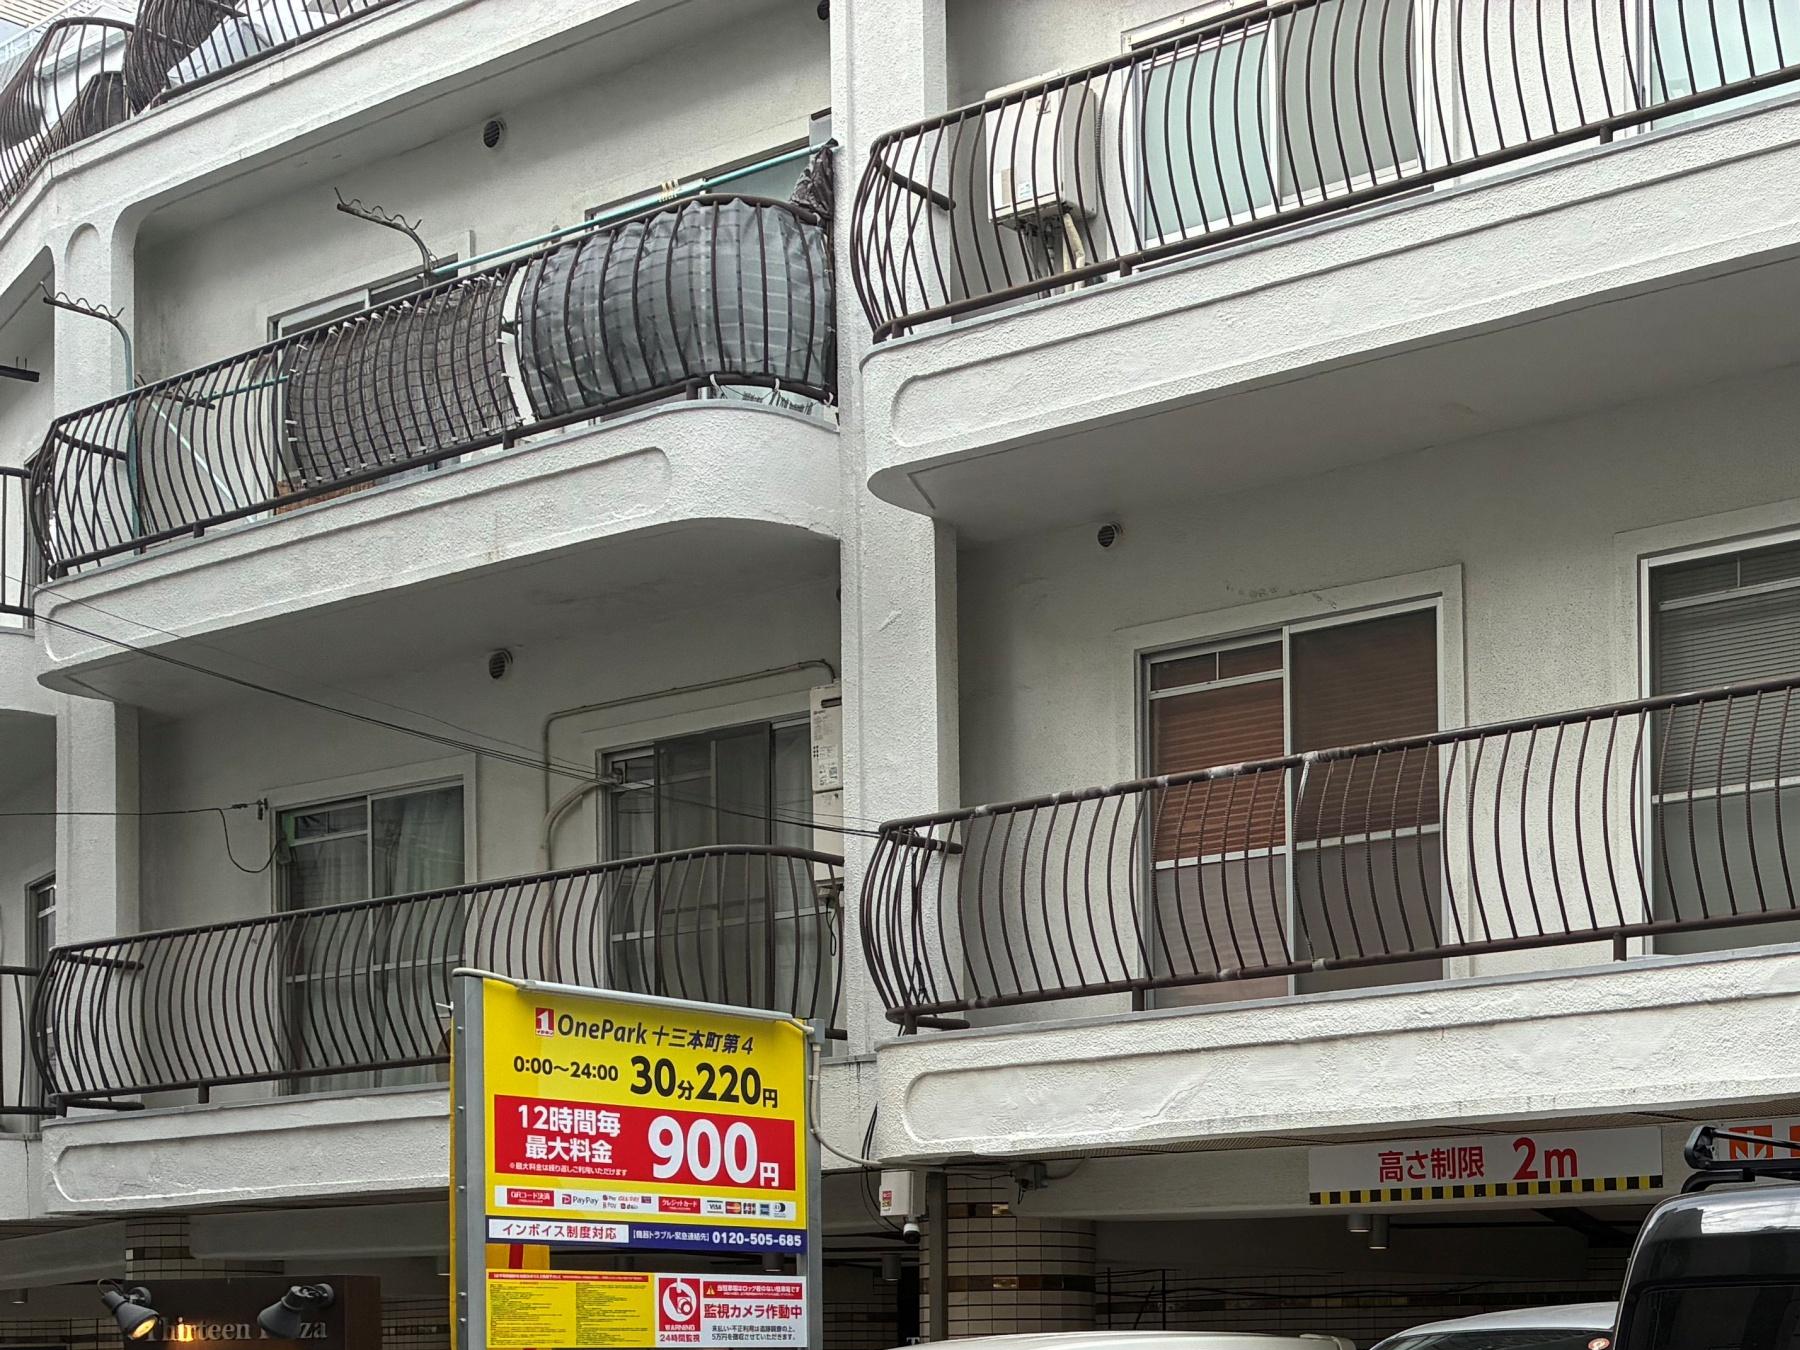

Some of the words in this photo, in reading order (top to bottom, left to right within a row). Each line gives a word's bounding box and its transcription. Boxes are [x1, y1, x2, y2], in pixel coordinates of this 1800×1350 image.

[557, 1013, 648, 1045] OnePark
[517, 1104, 621, 1137] 12時間毎
[525, 1134, 613, 1164] 最大料金
[1378, 1146, 1485, 1183] 高さ制限
[1512, 1137, 1578, 1180] 2m
[502, 1223, 617, 1240] インボイス制度対応
[712, 1230, 802, 1247] 0120-505-685
[703, 1303, 803, 1320] 監視カメラ作動中
[664, 1324, 696, 1332] WARNING
[659, 1333, 701, 1343] 24時間監視
